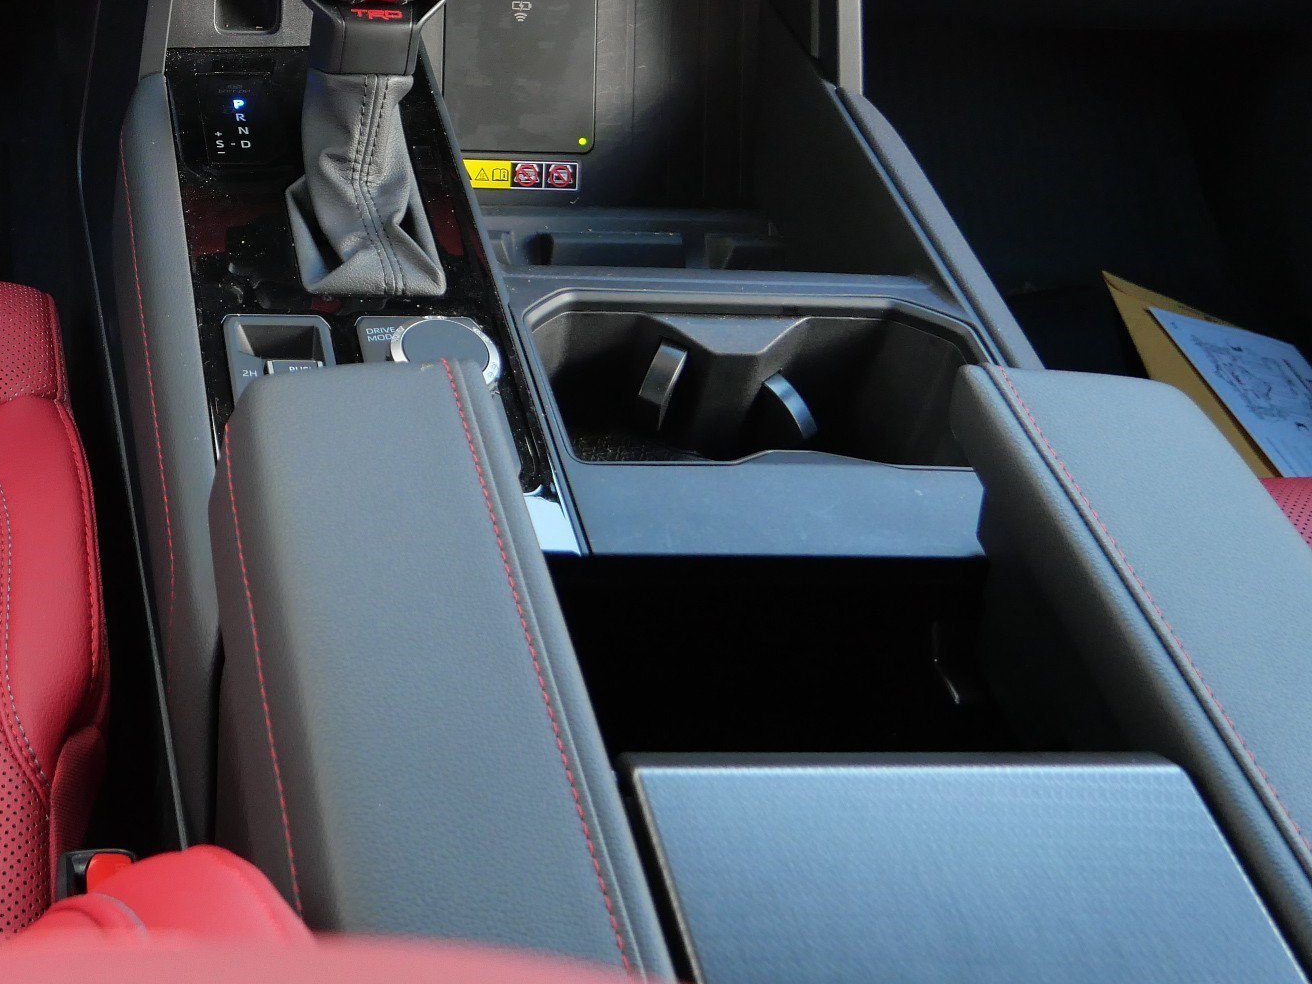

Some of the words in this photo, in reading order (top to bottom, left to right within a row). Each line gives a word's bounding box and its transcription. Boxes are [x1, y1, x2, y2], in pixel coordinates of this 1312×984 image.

[351, 9, 403, 20] TRD
[233, 99, 245, 109] P
[235, 113, 246, 121] R
[216, 140, 225, 148] S
[241, 140, 251, 148] D
[366, 326, 395, 335] DRIVE
[367, 333, 394, 342] MOD
